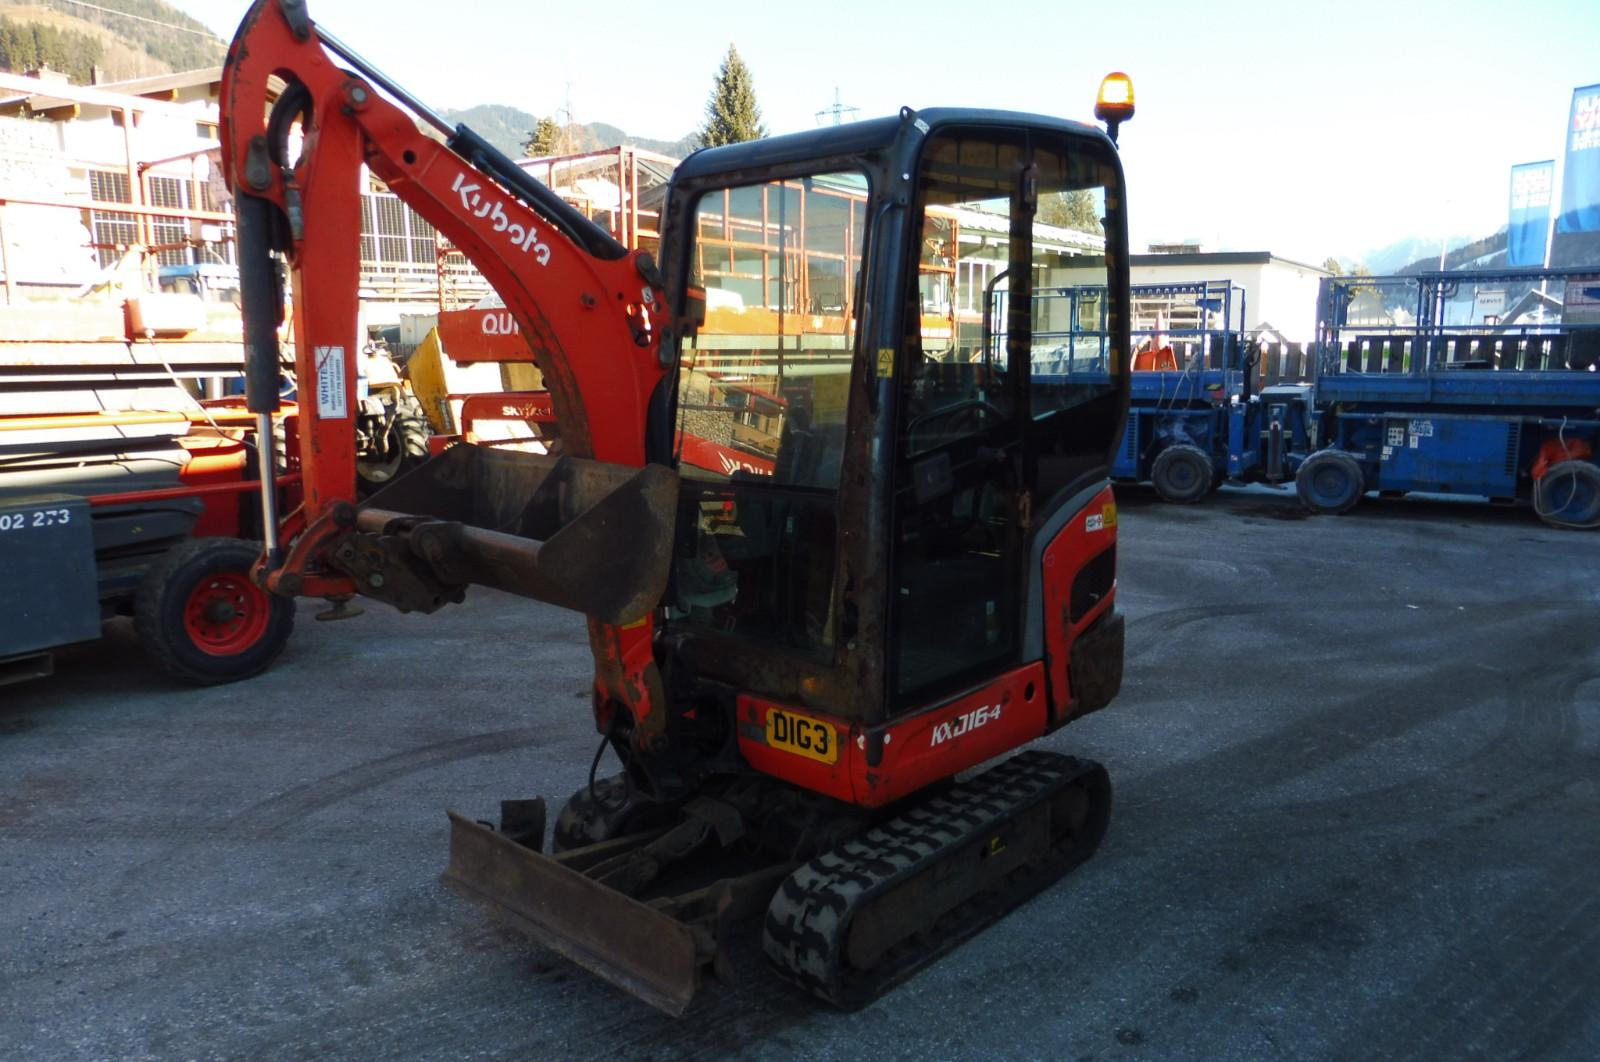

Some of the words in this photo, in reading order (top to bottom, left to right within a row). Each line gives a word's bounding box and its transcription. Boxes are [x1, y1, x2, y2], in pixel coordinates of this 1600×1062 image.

[451, 172, 551, 267] Kubota
[320, 362, 329, 404] WHITE
[0, 514, 25, 530] 02
[32, 509, 70, 527] 273
